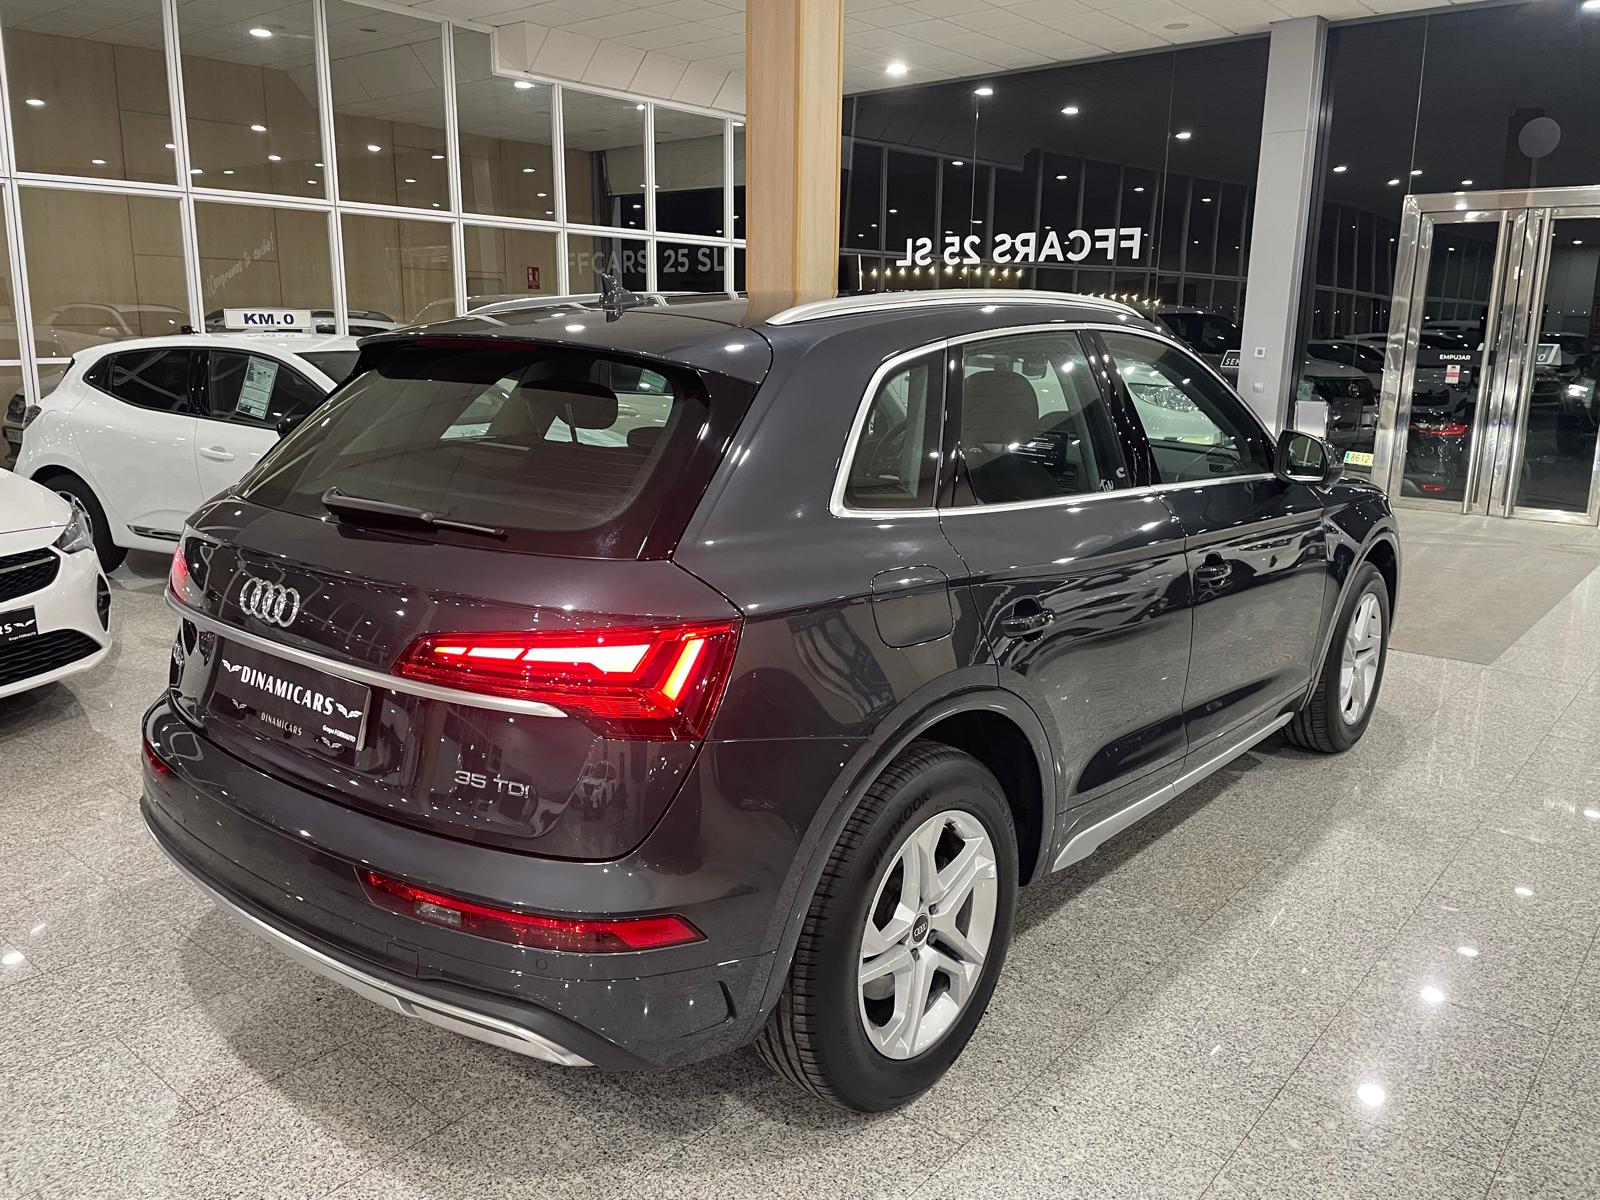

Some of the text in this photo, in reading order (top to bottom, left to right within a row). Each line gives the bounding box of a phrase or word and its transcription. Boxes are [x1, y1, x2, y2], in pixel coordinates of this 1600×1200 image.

[663, 248, 690, 273] 25
[697, 246, 725, 272] SL
[243, 313, 295, 325] KM.0
[1439, 353, 1471, 361] EMPUJAR
[241, 666, 335, 716] DINAMICARS
[260, 711, 304, 737] DINAMICARS
[454, 769, 531, 799] 35 TDI
